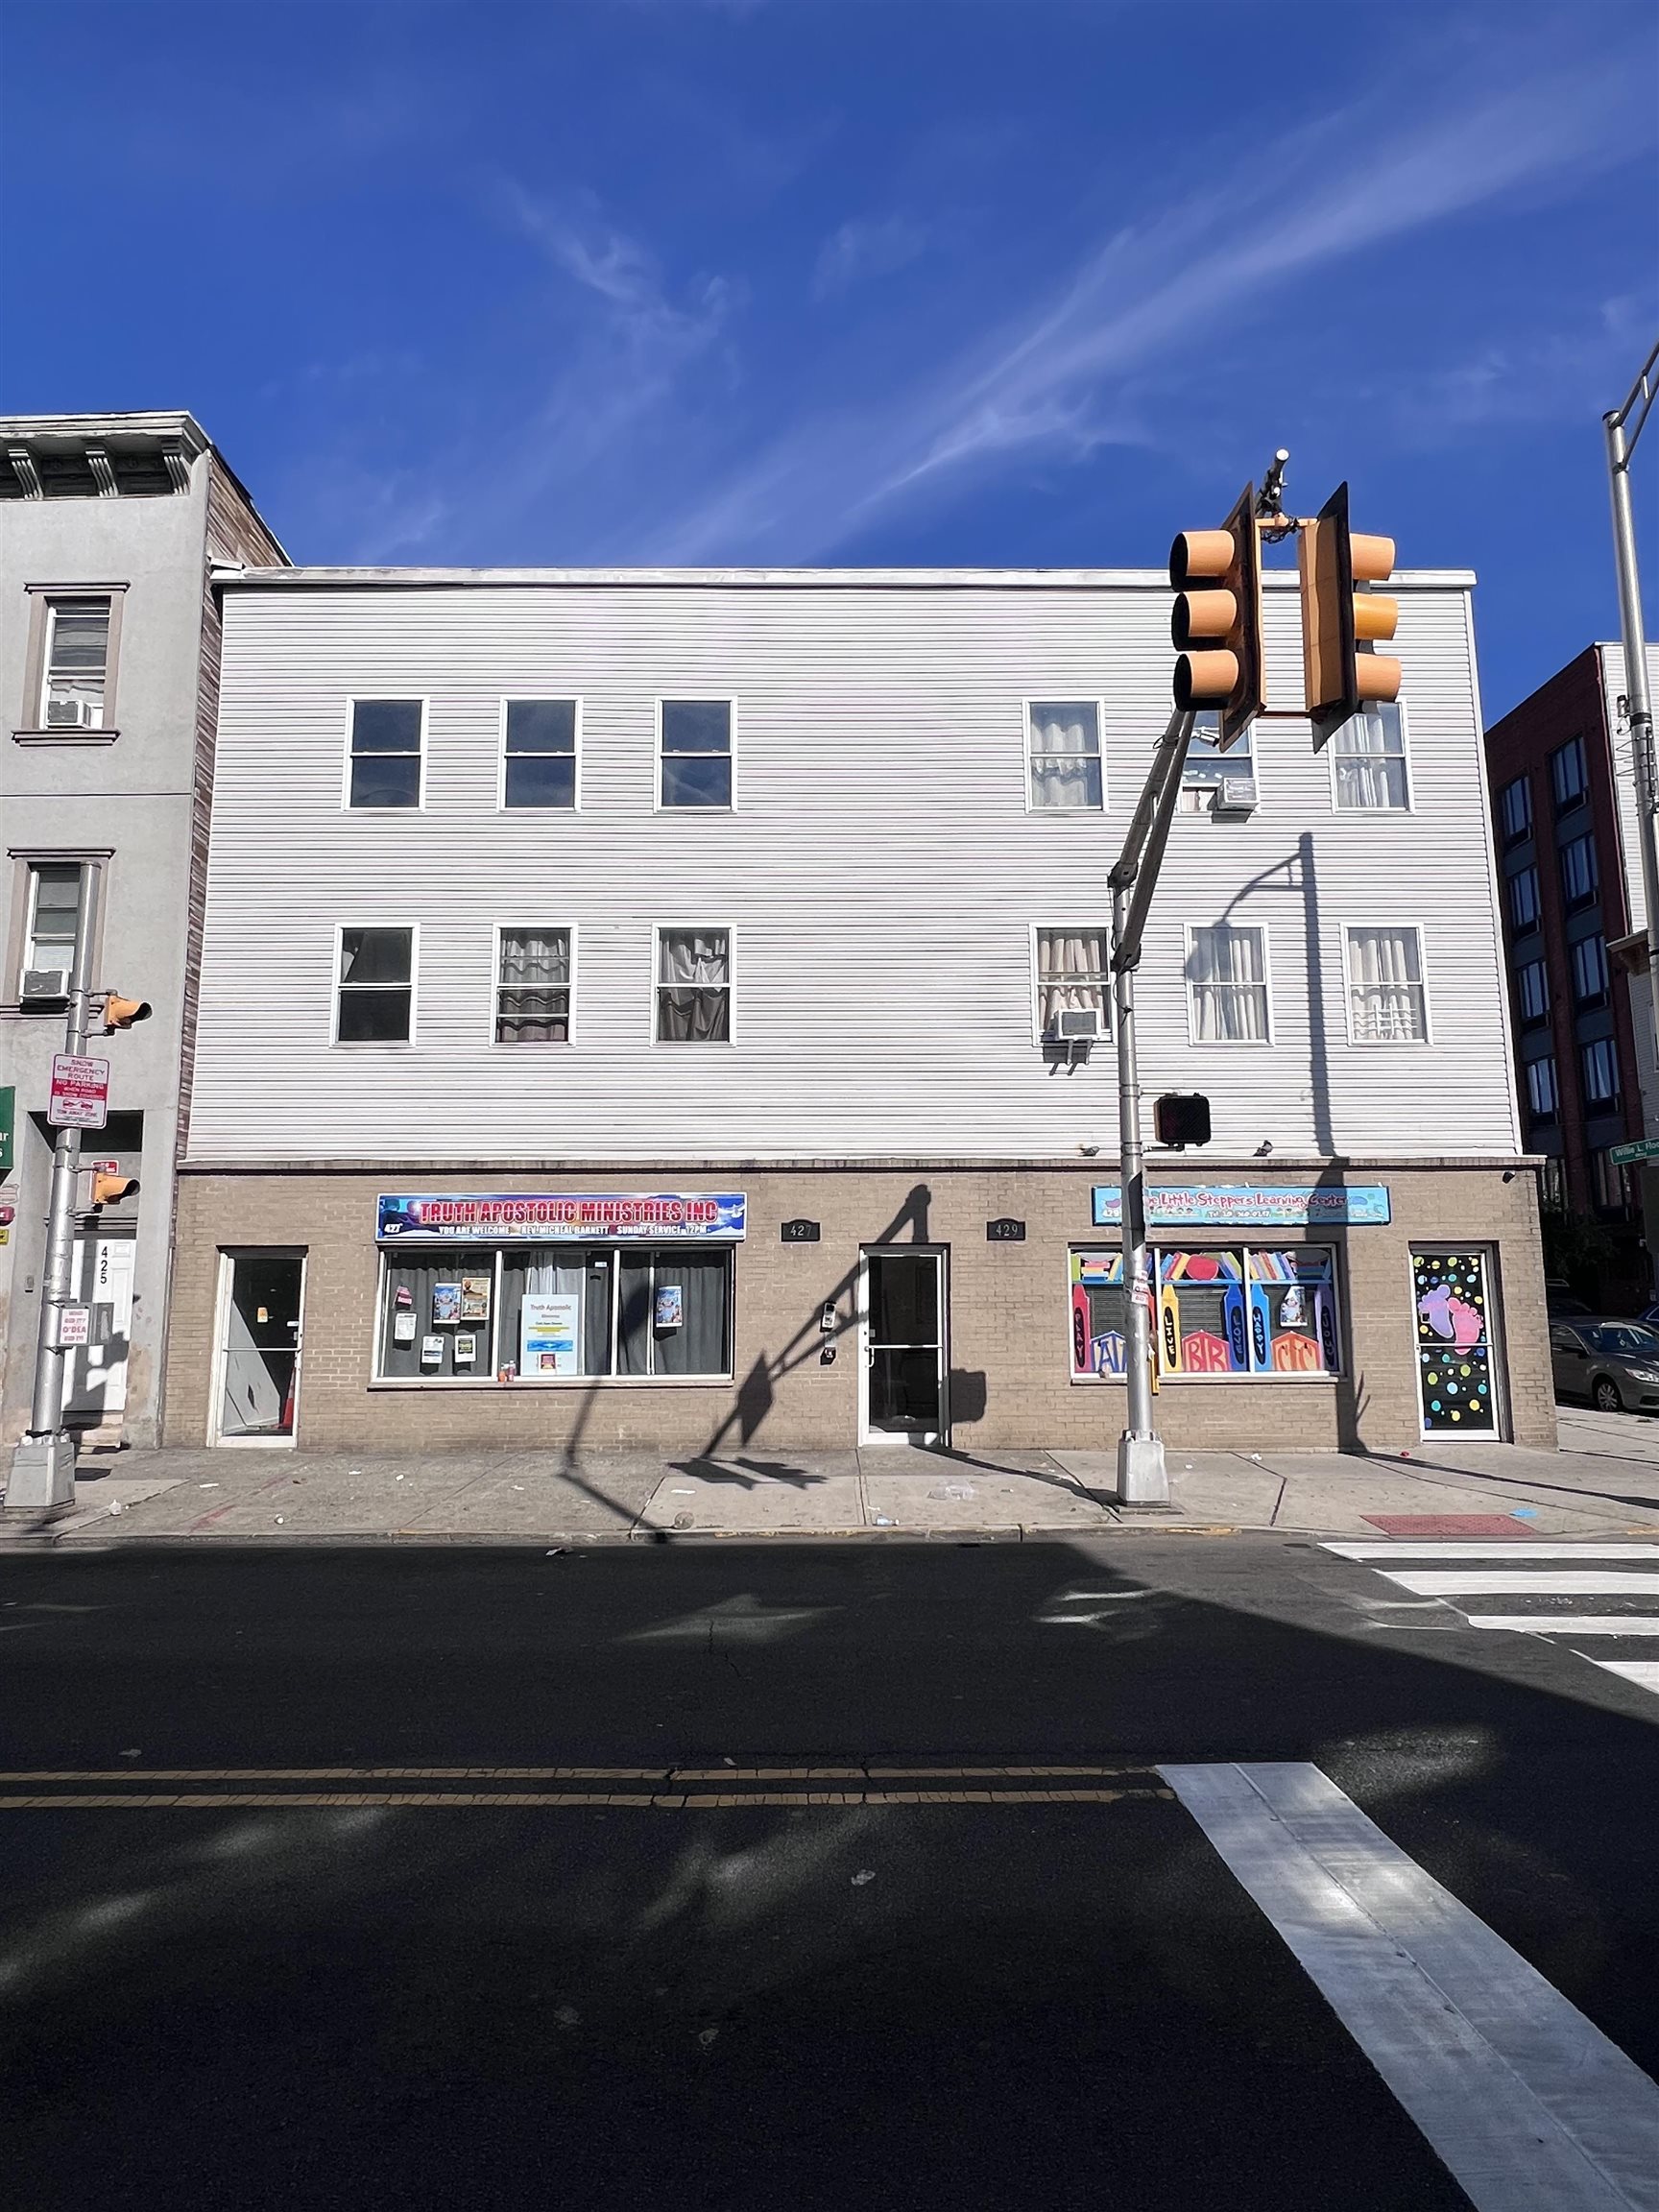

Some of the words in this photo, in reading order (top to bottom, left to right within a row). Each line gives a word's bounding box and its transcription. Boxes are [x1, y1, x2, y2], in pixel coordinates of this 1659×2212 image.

[58, 1065, 105, 1075] EMERGENCY
[1161, 1192, 1195, 1206] Little
[1197, 1192, 1254, 1208] Steppers
[1257, 1192, 1308, 1209] Learning
[1309, 1193, 1349, 1206] Center
[420, 1202, 477, 1223] TRUTH
[480, 1202, 577, 1223] APOSTOLIC
[580, 1201, 683, 1223] MINISTRIES
[685, 1201, 718, 1222] INC
[439, 1226, 455, 1236] YOU
[455, 1226, 470, 1236] ARE
[471, 1226, 511, 1235] WELCOME
[540, 1226, 573, 1235] MICHEAL
[574, 1226, 610, 1235] BARNETT
[616, 1226, 647, 1235] SUNDAY
[649, 1226, 681, 1235] SERVICE
[790, 1223, 812, 1237] 427
[996, 1223, 1019, 1236] 429
[100, 1246, 108, 1285] 425
[1165, 1315, 1176, 1355] LIVE
[1233, 1314, 1243, 1355] LOVE
[1253, 1313, 1264, 1355] HAPPY
